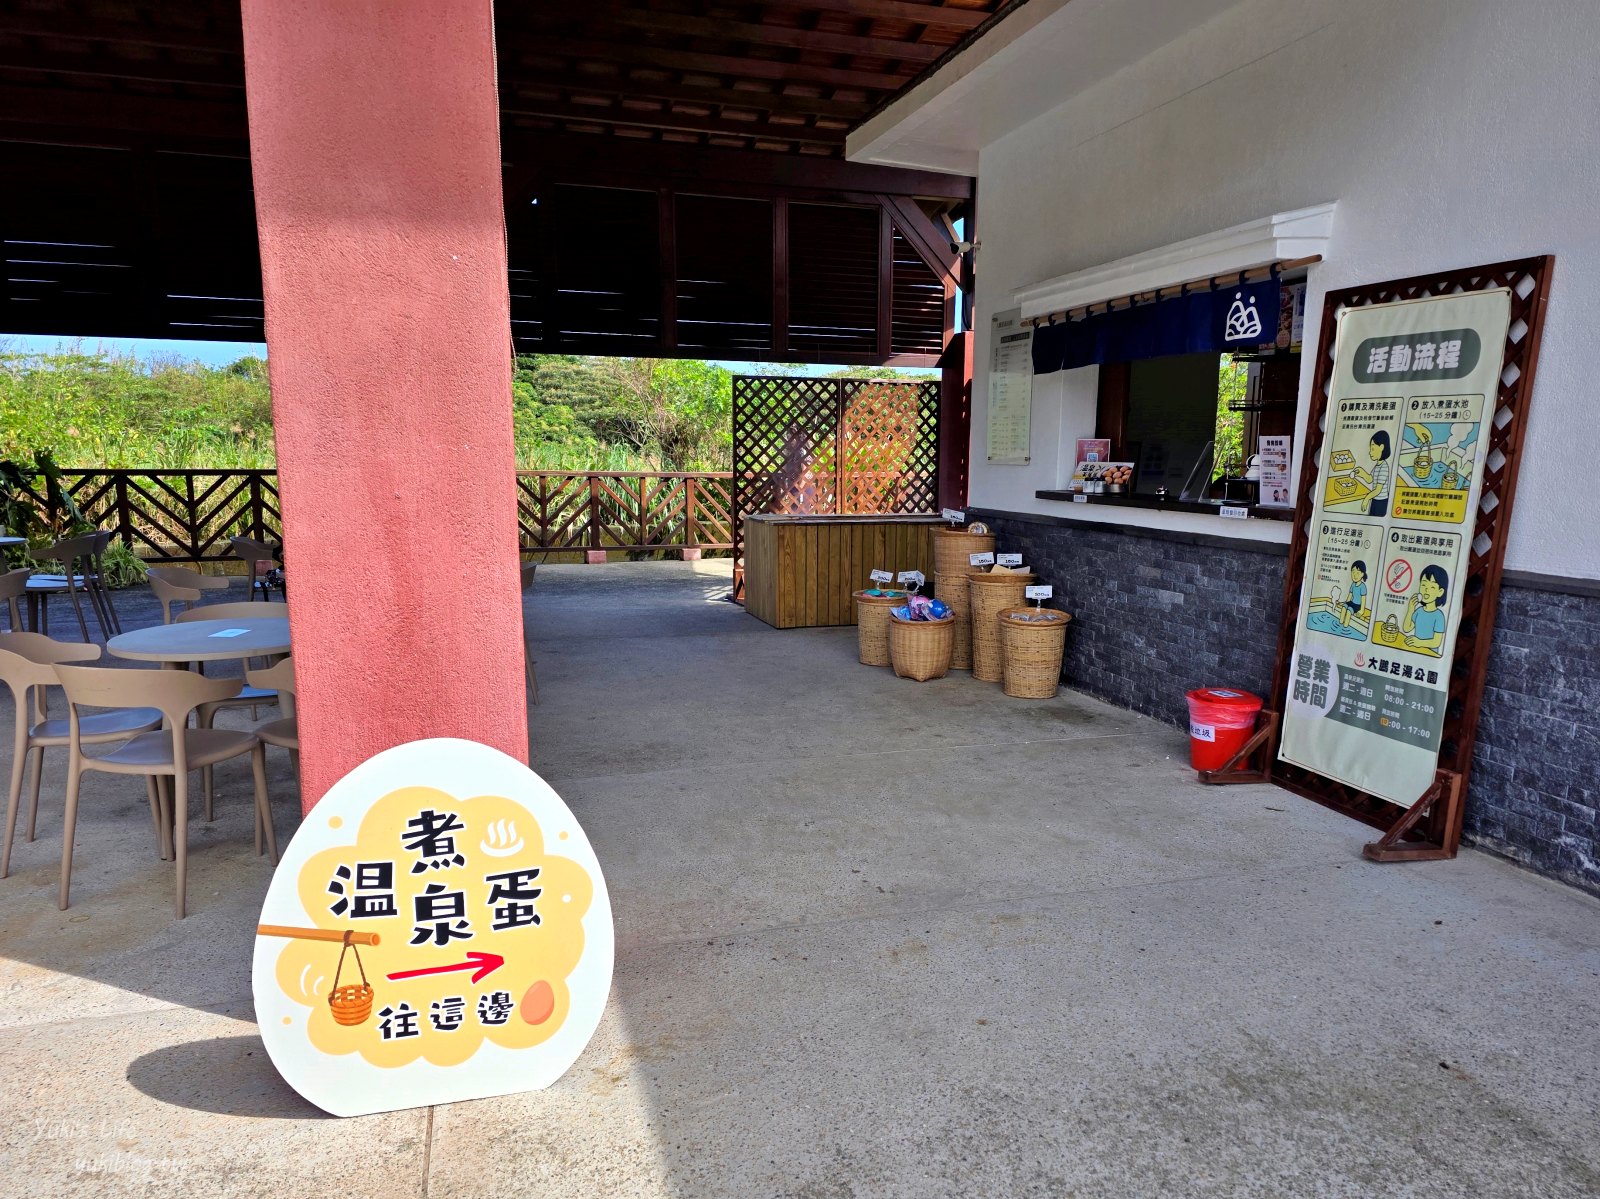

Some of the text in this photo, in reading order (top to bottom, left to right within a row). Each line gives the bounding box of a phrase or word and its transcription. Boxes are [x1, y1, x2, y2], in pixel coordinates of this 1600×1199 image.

[1367, 340, 1462, 374] 活動流程
[1422, 399, 1469, 409] 放入煮蛋水池
[1330, 527, 1364, 538] 進行足湯浴
[1401, 534, 1454, 548] 取出雞蛋與享用
[1298, 653, 1331, 685] 營業
[1367, 656, 1439, 685] 大鵬足湯公園
[1292, 679, 1328, 710] 時間
[1384, 693, 1404, 706] 08:00
[1411, 701, 1434, 714] 21:00
[1408, 725, 1430, 738] 17:00
[401, 809, 465, 874] 煮
[378, 991, 514, 1040] 往這邊
